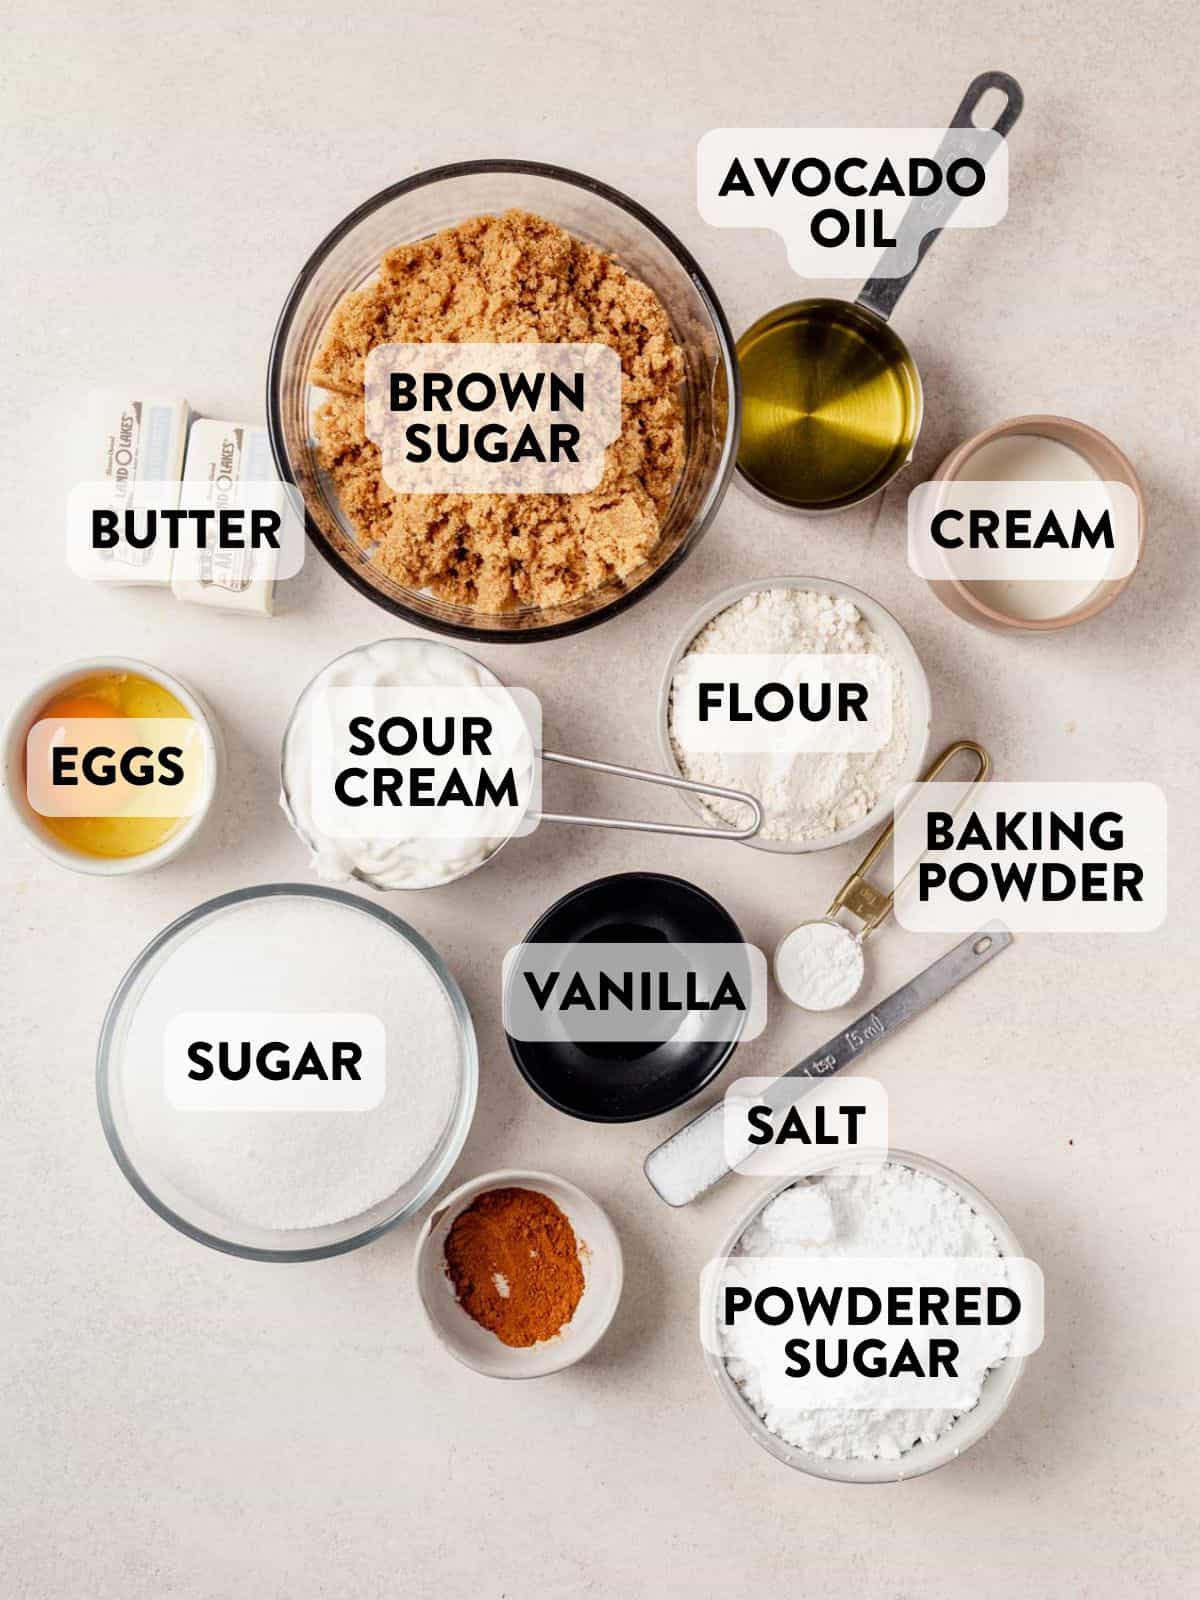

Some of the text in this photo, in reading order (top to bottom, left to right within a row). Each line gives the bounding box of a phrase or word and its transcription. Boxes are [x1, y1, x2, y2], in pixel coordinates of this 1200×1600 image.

[120, 414, 134, 448] LAKES
[220, 441, 235, 474] LAKES
[813, 1055, 837, 1073] tsp
